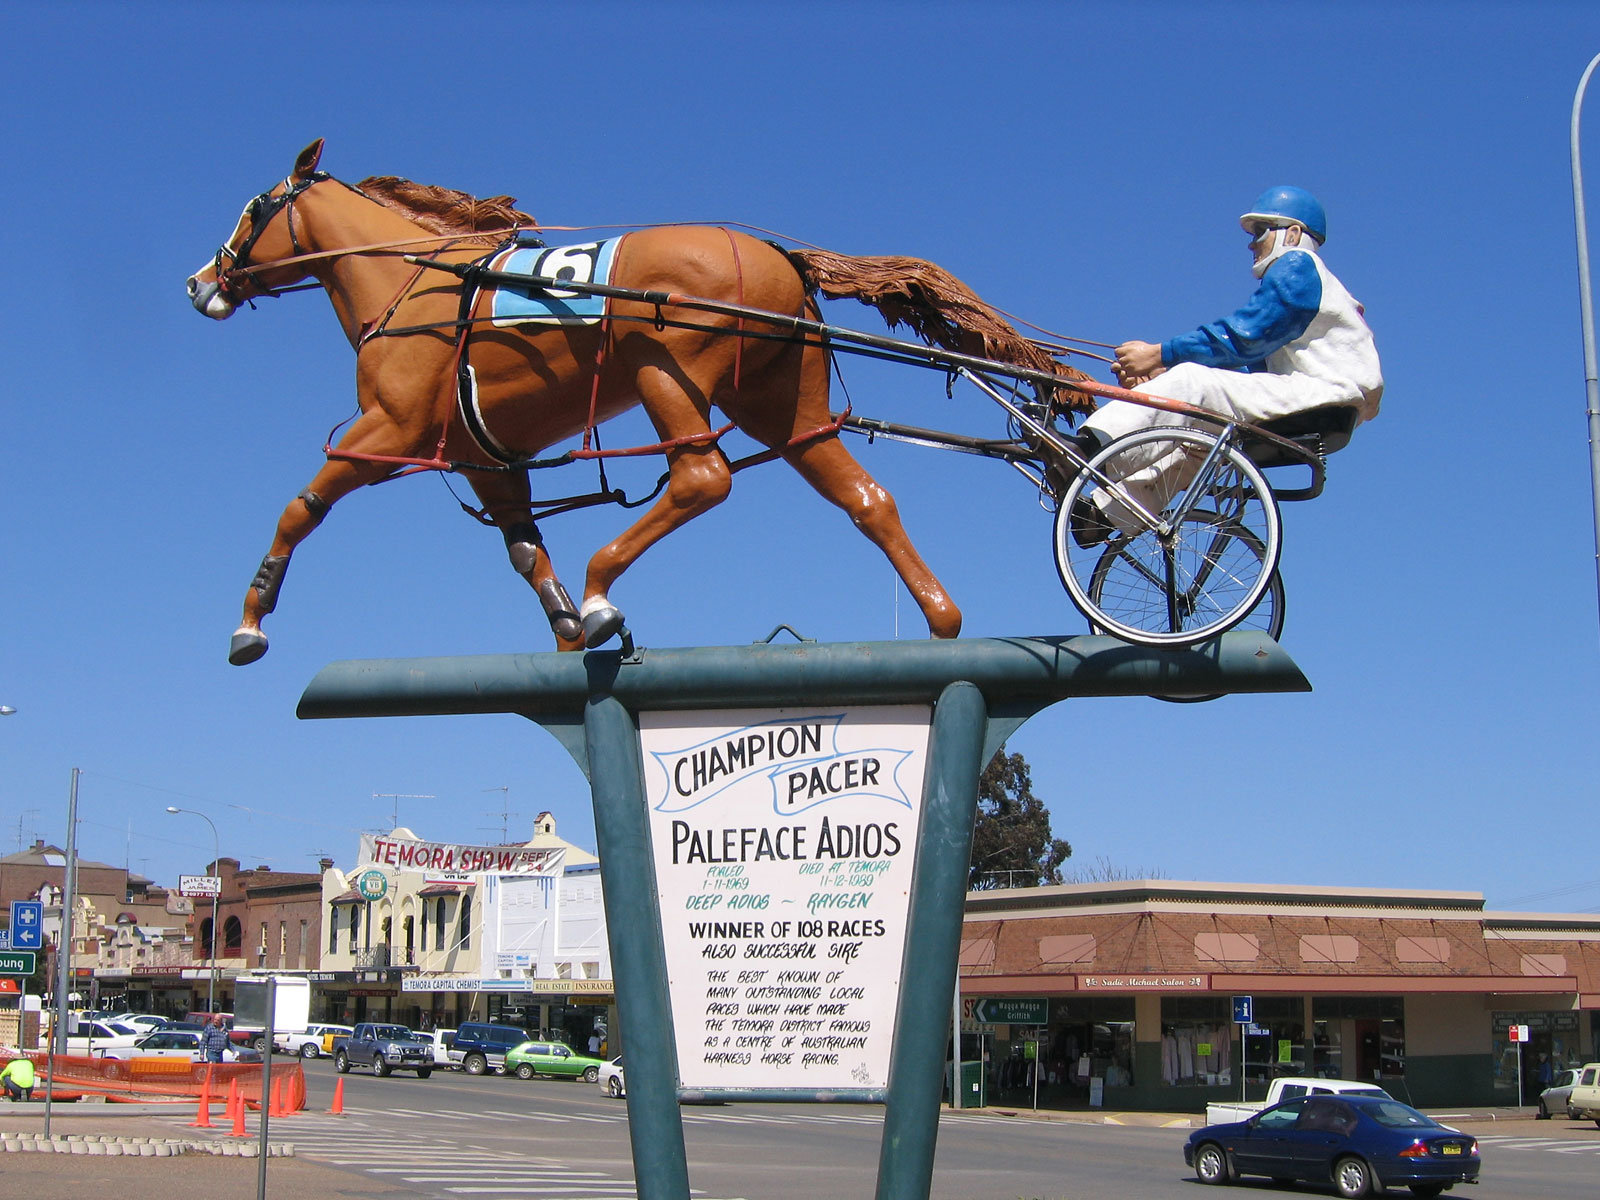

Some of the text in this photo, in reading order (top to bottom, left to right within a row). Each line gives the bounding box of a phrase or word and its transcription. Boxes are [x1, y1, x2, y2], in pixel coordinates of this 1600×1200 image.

[674, 724, 822, 797] CHAMPION
[788, 758, 881, 804] PACER
[672, 815, 901, 864] PALEFACE ADIOS
[375, 840, 453, 870] TEMORA
[460, 850, 517, 872] SHOW
[707, 860, 892, 878] FOALED DIED AT TEMORA
[703, 874, 874, 890] 1-11-1969 11-12-1989
[686, 894, 723, 910] DEEP
[727, 894, 770, 910] ADIOS
[806, 892, 874, 915] RAYGEN
[689, 919, 885, 939] WINNER OF 108 RACES
[702, 942, 863, 964] ALSO SUCCESSFUL SIRE
[409, 981, 432, 990] TEMORA
[433, 981, 456, 990] CAPITAL
[456, 980, 481, 990] CHEMIST
[575, 982, 614, 991] INSURANCE
[707, 970, 844, 986] THE BEST KNOWN OF
[1101, 978, 1185, 986] Sadie Michael Salon
[706, 985, 865, 1000] MANY OUTSTANDING LOCAL
[747, 1003, 780, 1015] WHICH
[784, 1003, 814, 1015] HAVE
[816, 1003, 850, 1015] MADE
[999, 1002, 1040, 1011] Wagga Wagga
[705, 1018, 871, 1035] THE TEMORA DISTRICT FAMOUS
[704, 1035, 868, 1050] AS A CENTRE OF AUSTRALIAN
[703, 1052, 752, 1067] HARNESS
[760, 1052, 795, 1069] HORSE
